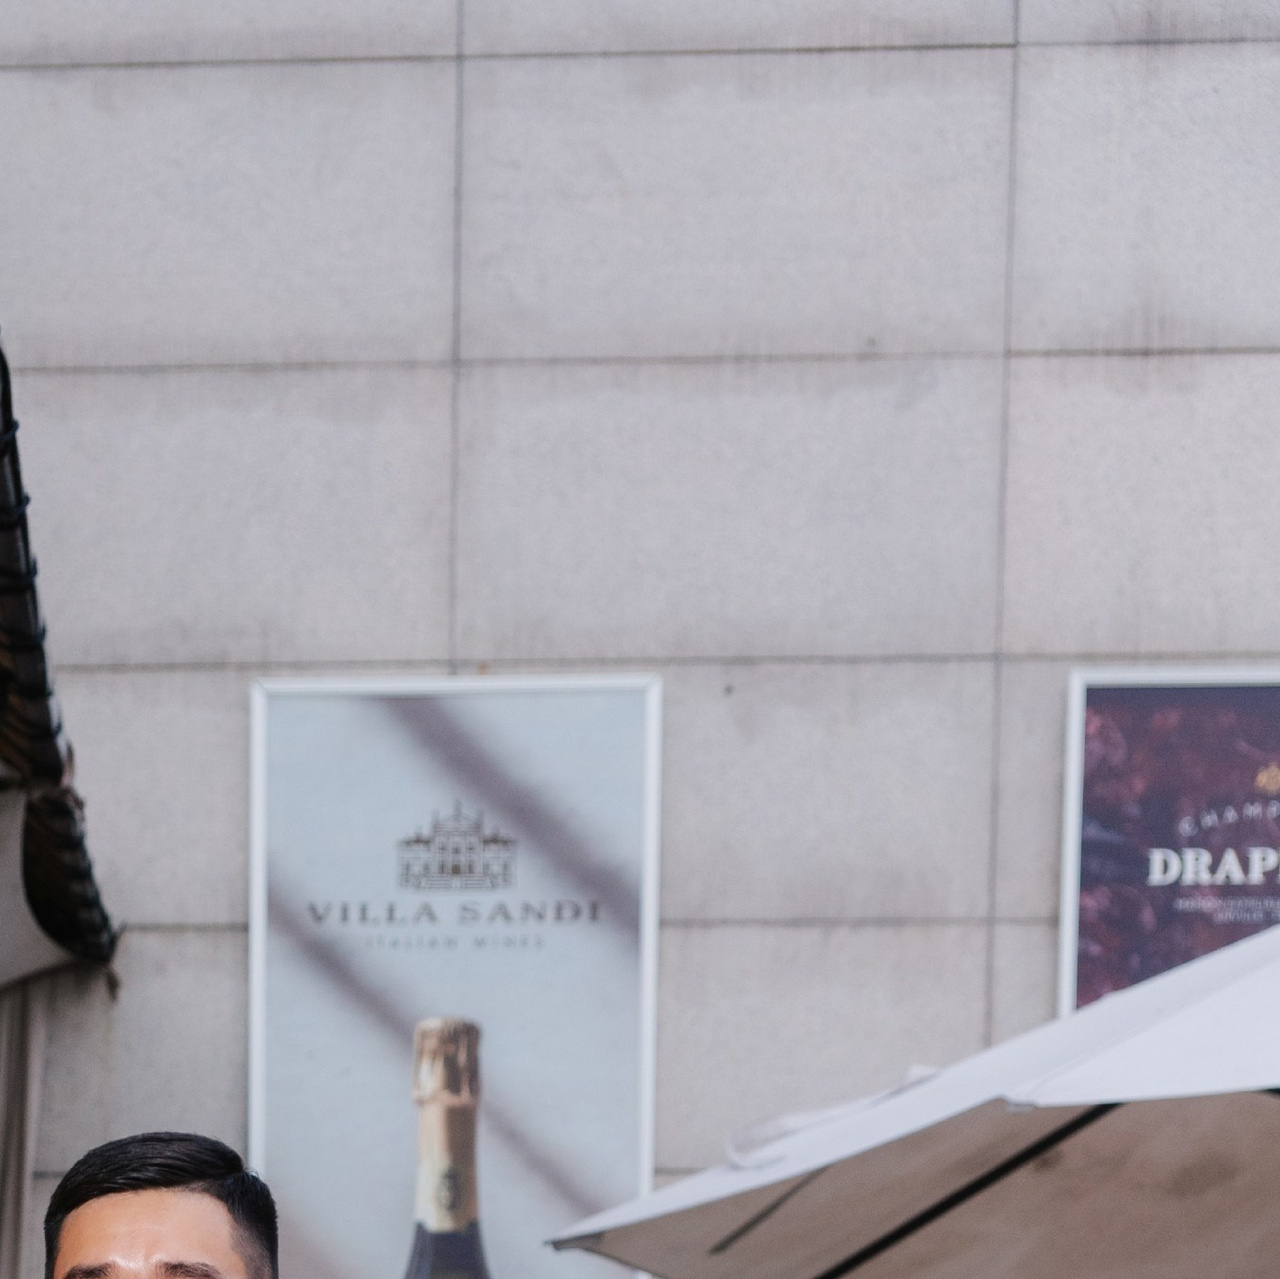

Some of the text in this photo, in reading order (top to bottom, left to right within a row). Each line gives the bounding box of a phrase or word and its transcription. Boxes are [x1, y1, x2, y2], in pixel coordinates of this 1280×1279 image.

[1147, 846, 1280, 886] DRAP
[308, 901, 602, 926] VILLA SANDI
[365, 933, 546, 950] ITALIAN WINES
